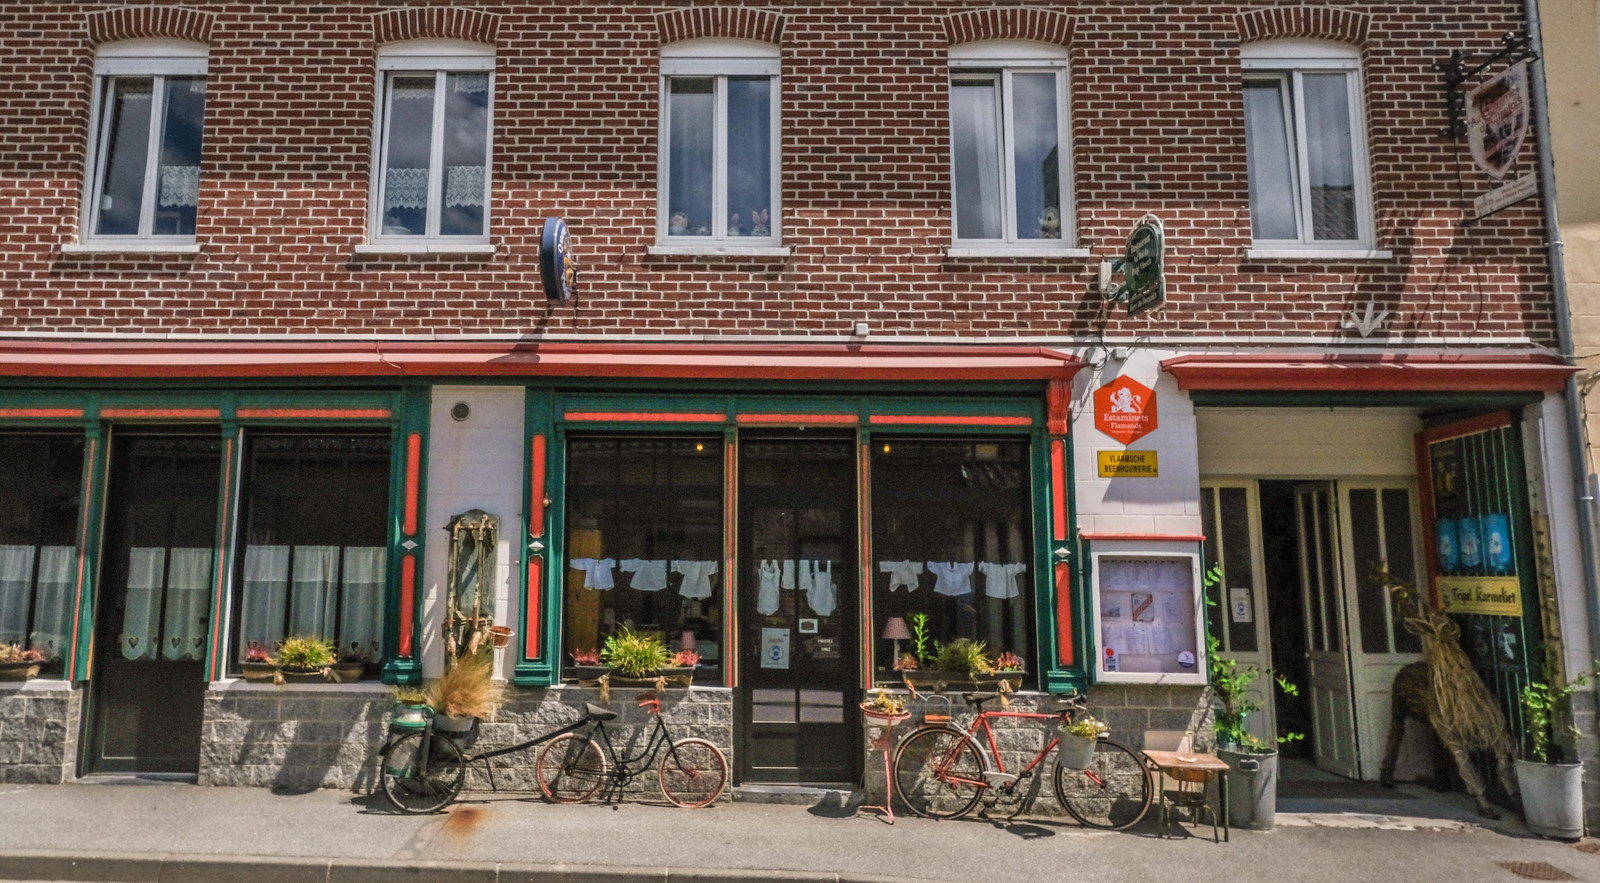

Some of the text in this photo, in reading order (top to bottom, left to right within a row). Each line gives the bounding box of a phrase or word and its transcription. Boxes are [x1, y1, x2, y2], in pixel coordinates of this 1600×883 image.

[1104, 413, 1149, 422] Estaminets
[1109, 455, 1146, 463] VLAAMSCHE
[1104, 464, 1152, 473] BEENHOUWERIE
